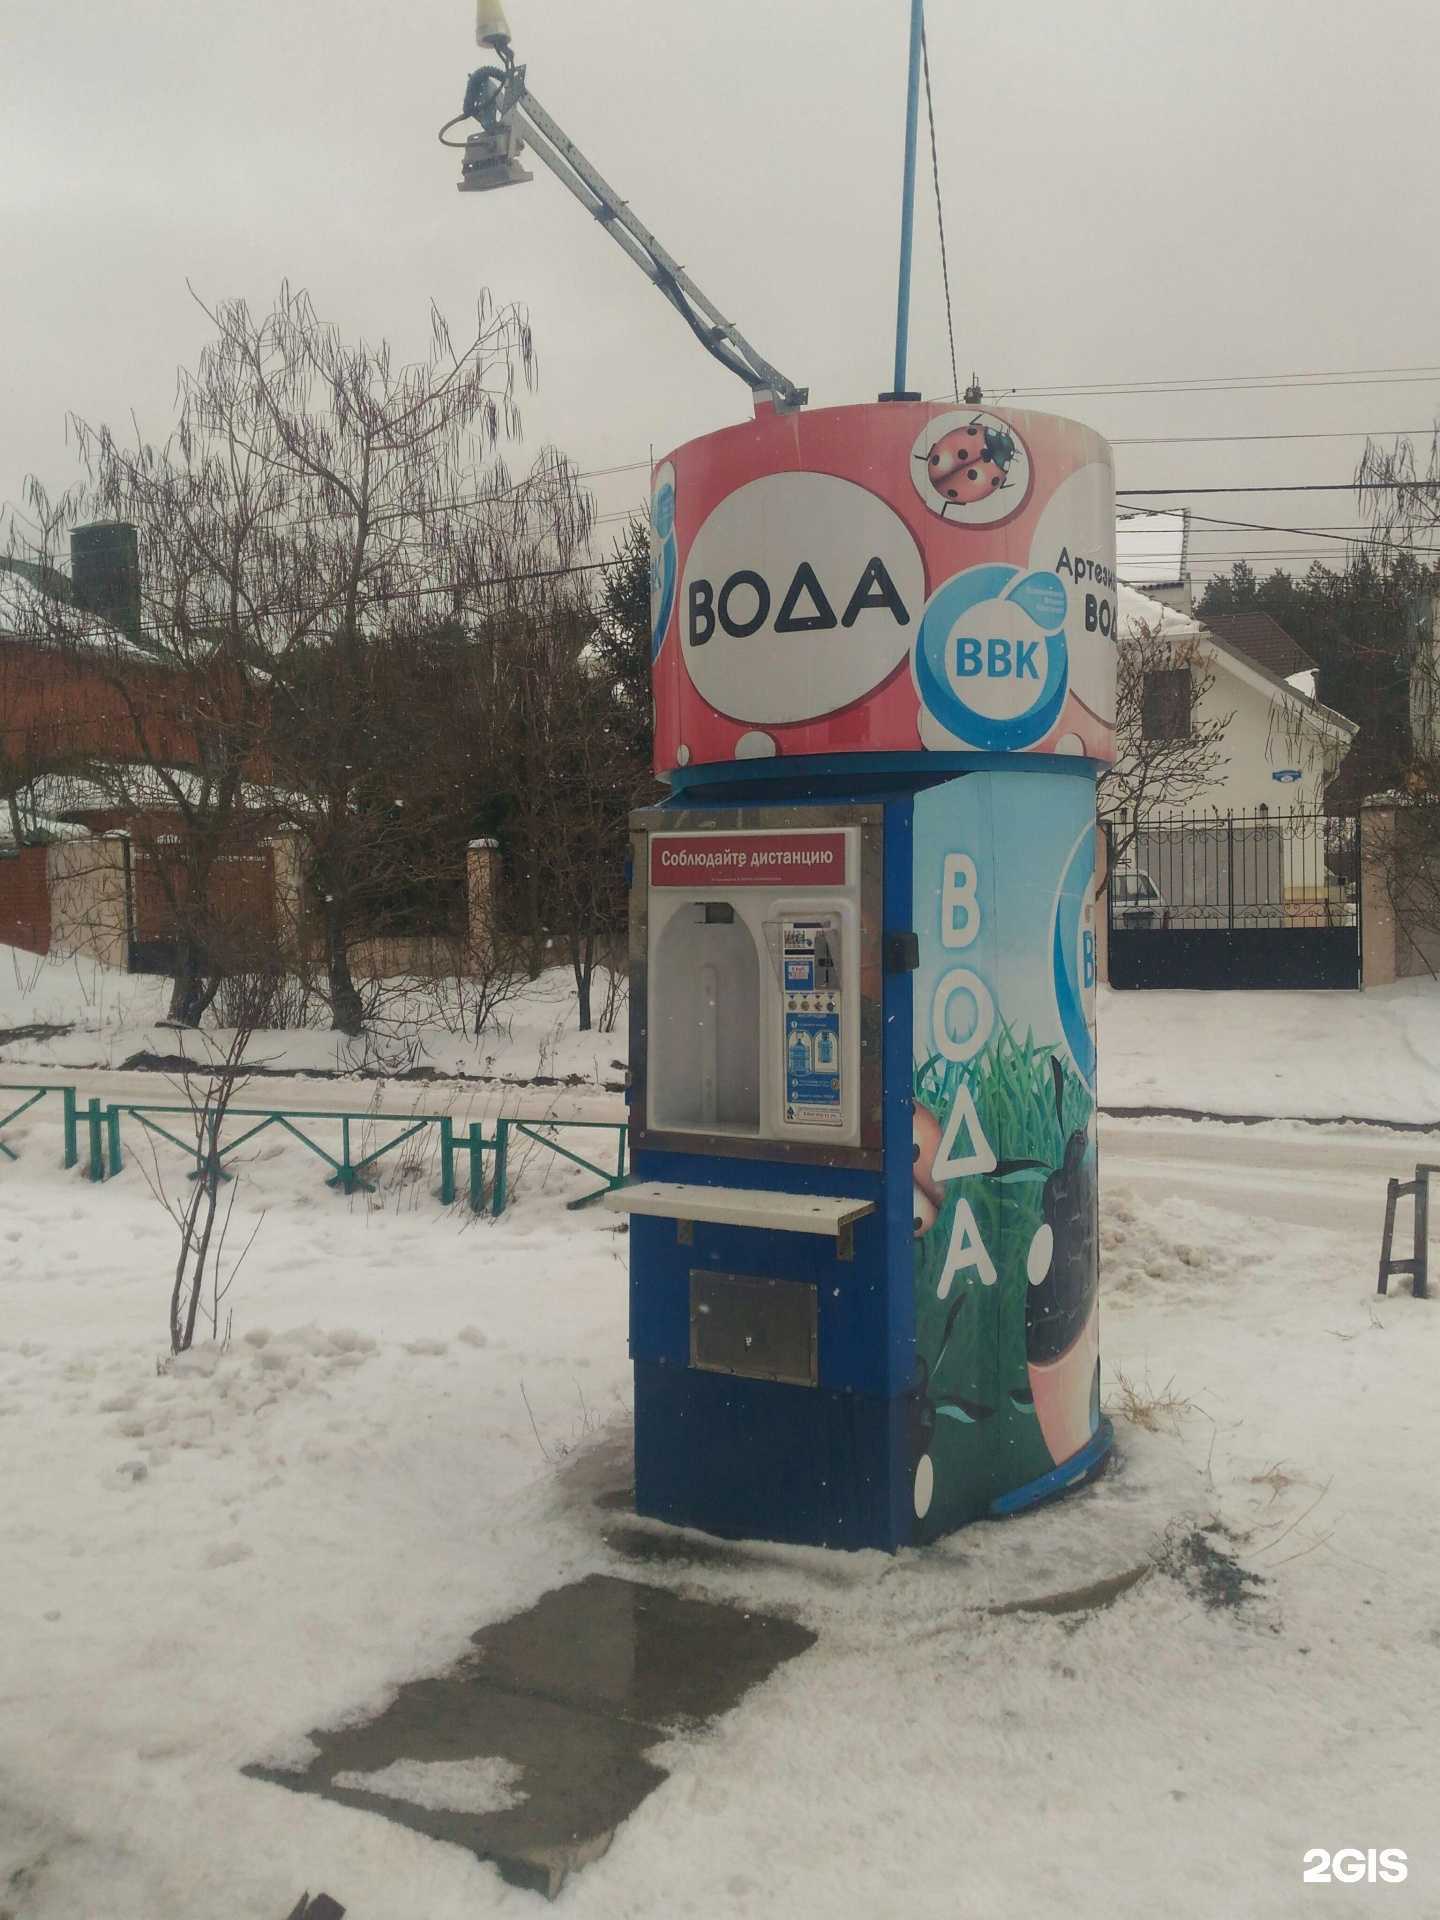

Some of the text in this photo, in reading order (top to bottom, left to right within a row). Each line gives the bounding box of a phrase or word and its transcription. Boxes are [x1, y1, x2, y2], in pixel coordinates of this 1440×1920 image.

[689, 556, 911, 647] ВОДА
[955, 636, 1041, 681] ВВК
[661, 848, 834, 868] Соблюдайте дистанцию
[931, 851, 998, 1300] ВОДА
